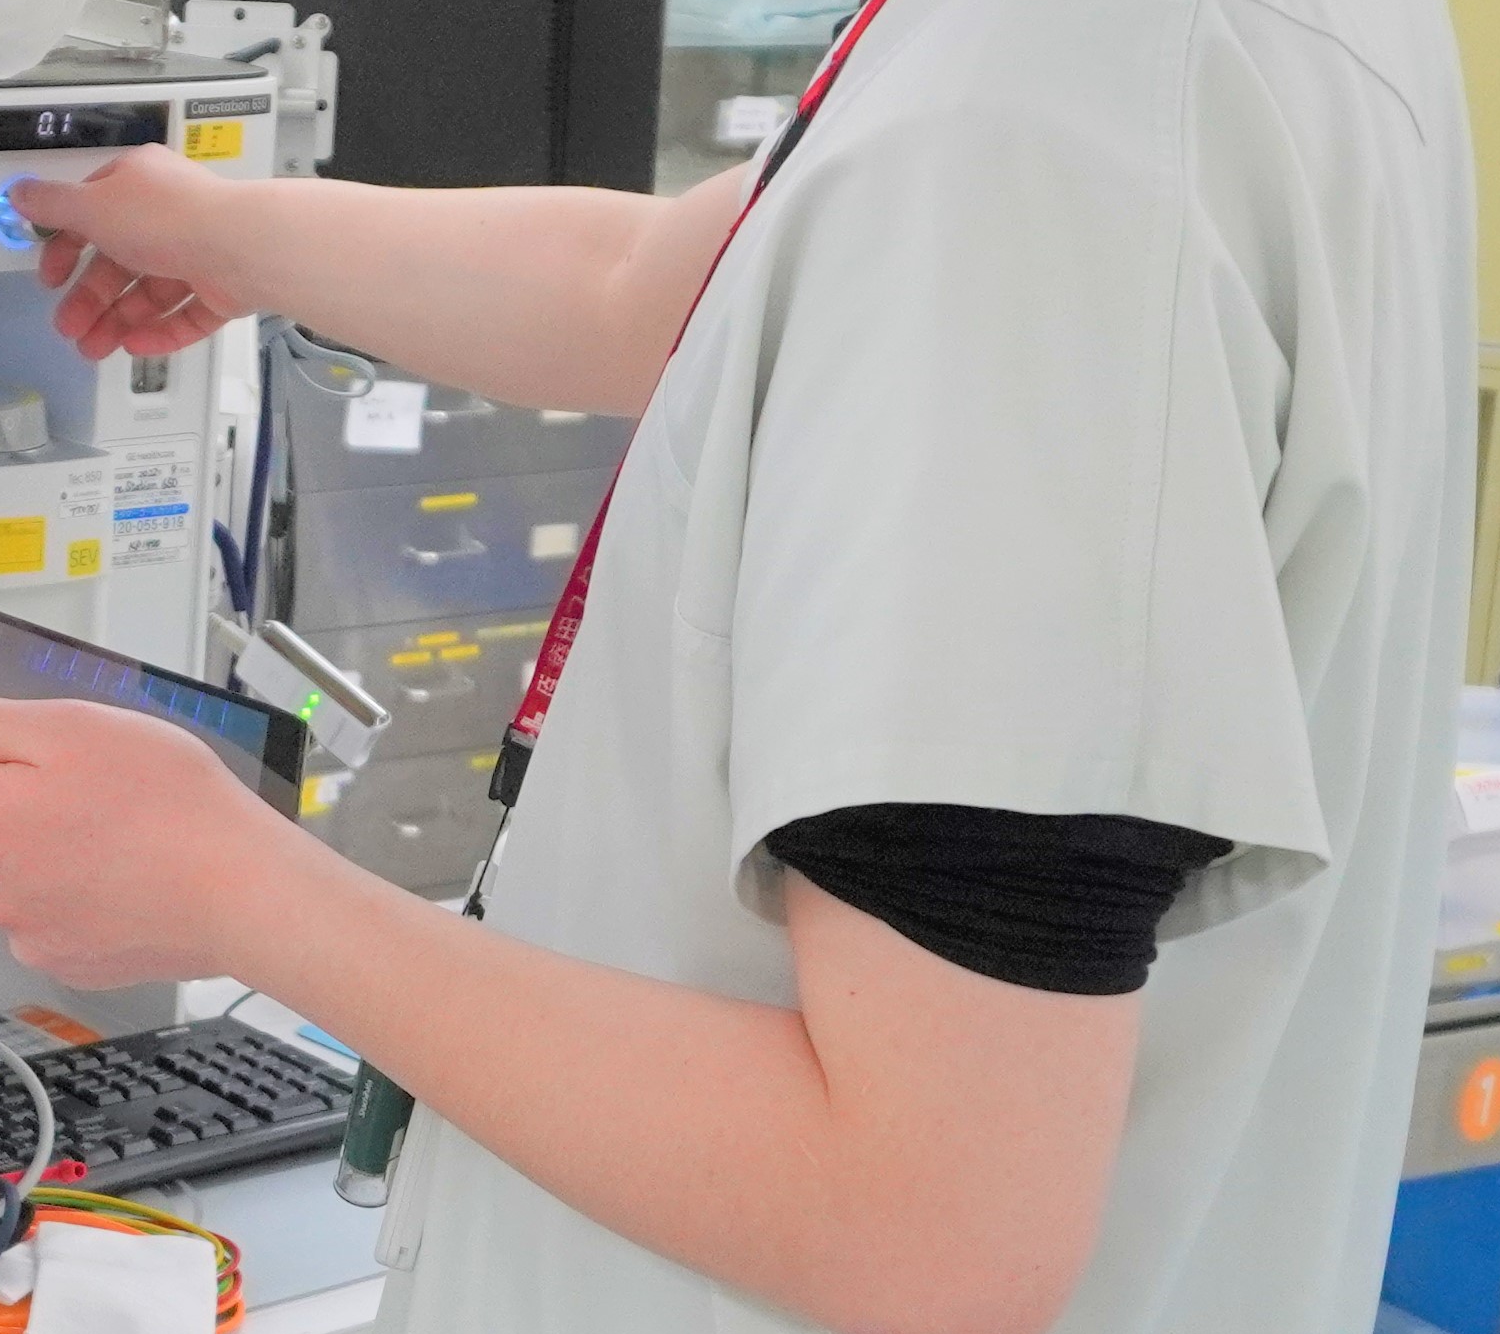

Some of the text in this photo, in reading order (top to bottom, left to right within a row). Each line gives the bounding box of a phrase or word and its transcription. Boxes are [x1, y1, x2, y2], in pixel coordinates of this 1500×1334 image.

[191, 99, 250, 115] Carestation
[37, 112, 71, 137] 0.1
[69, 548, 98, 568] SEV
[1481, 1074, 1496, 1126] 1
